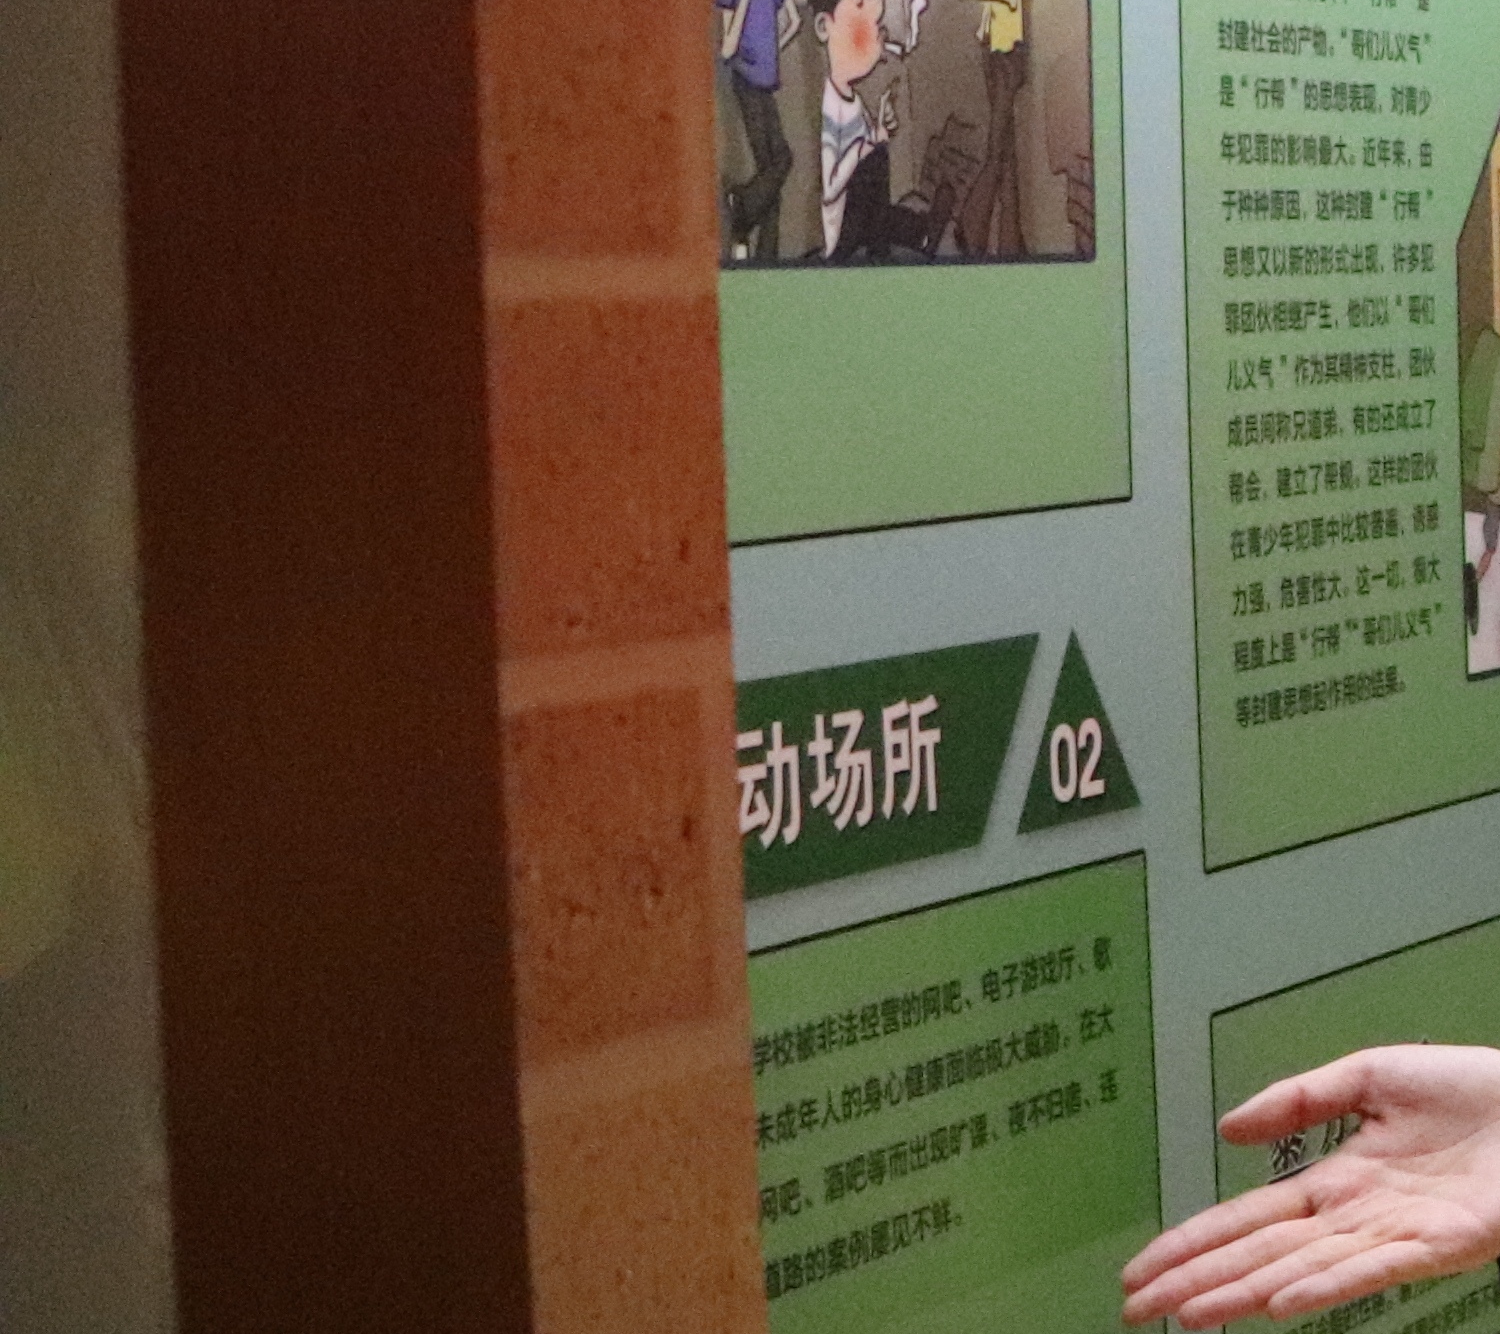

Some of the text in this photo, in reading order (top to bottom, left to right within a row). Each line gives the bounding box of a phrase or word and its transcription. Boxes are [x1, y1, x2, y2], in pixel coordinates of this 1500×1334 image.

[735, 694, 942, 850] 动场所
[1049, 716, 1105, 804] 02
